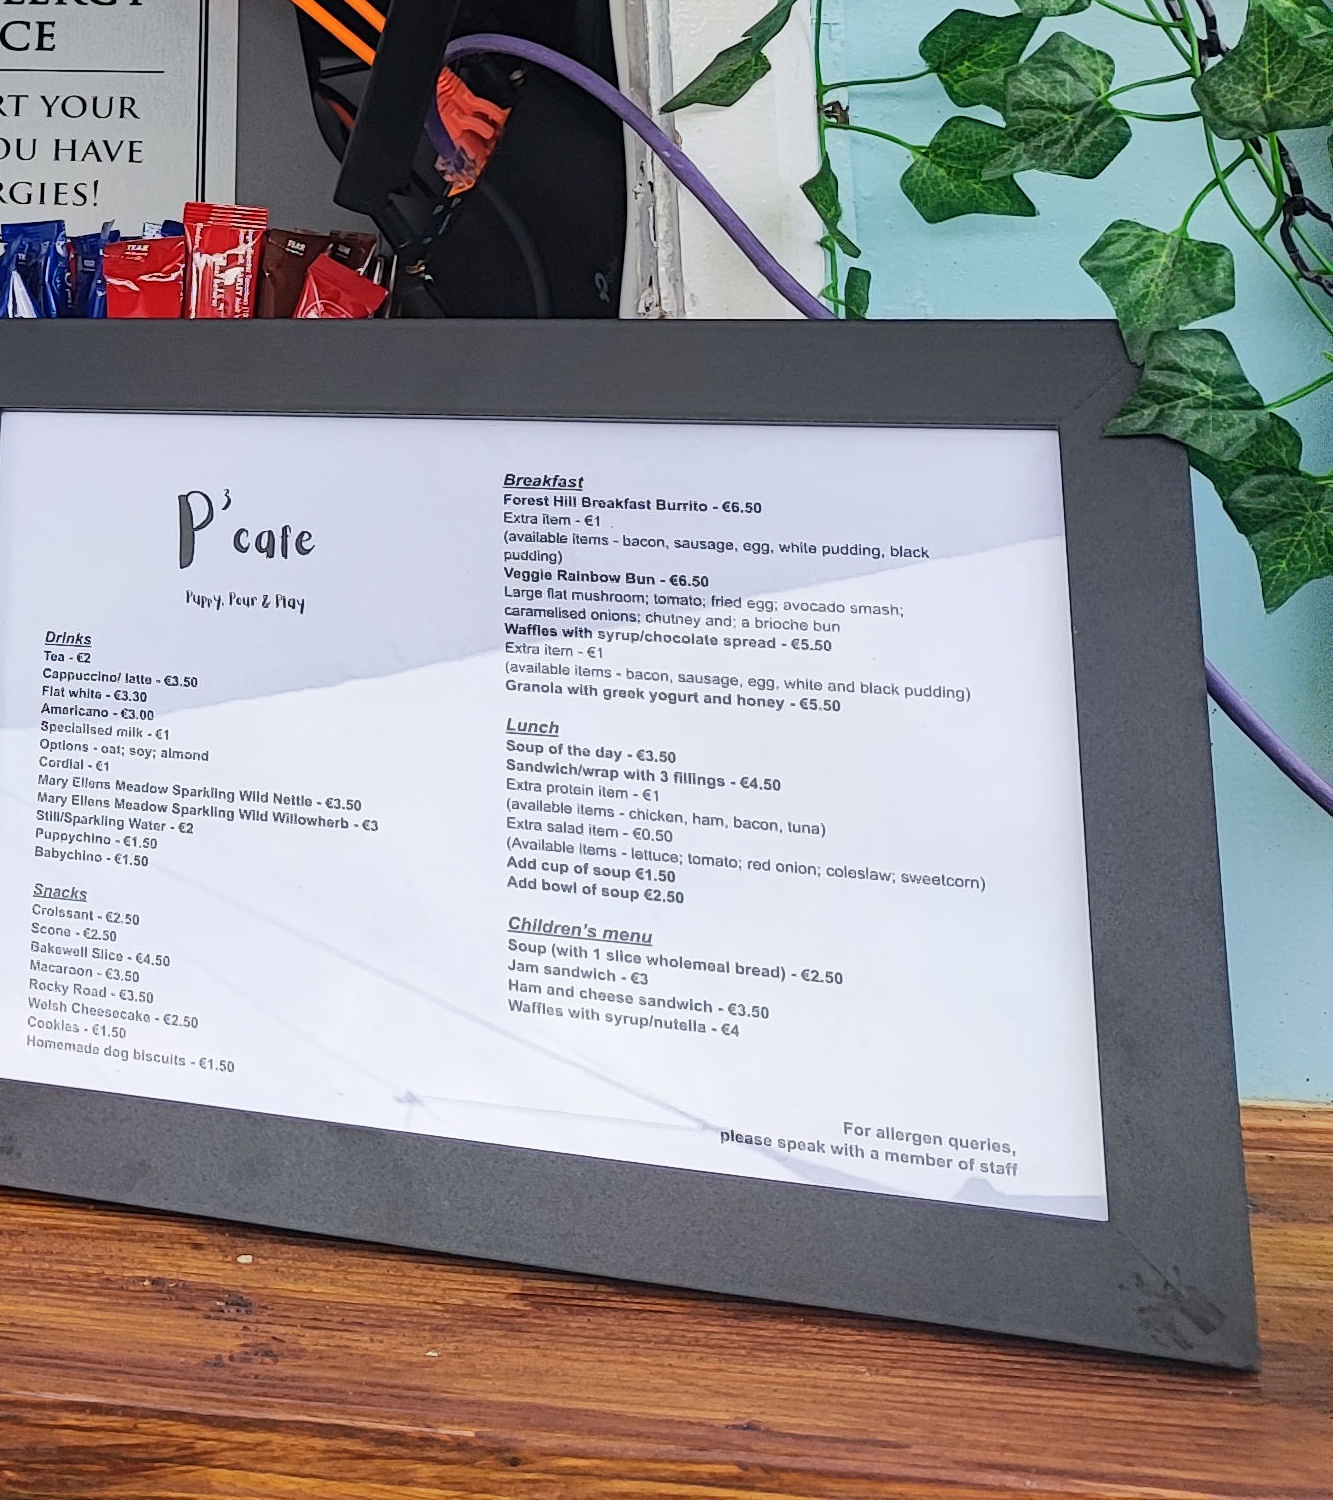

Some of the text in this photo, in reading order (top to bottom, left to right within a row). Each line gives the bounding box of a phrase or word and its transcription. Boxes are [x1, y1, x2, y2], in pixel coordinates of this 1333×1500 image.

[39, 95, 141, 120] YOUR
[52, 138, 144, 163] HAVE
[502, 473, 585, 489] Breakfast
[503, 493, 762, 514] Forest Hill Breakfast Burrito €6.50
[233, 524, 316, 560] cafe
[503, 566, 709, 588] Veggie Rainbow Bun €6.50
[228, 591, 258, 609] Pour
[261, 594, 271, 609] &
[275, 593, 305, 615] Play
[44, 630, 92, 646] Drinks
[43, 650, 91, 664] Tea €2
[41, 685, 65, 698] Flat
[113, 689, 148, 703] €3.30
[505, 679, 841, 712] Granola with greek yogurt and honey €5.50
[40, 702, 155, 721] Americano €3.00
[504, 717, 560, 736] Lunch
[506, 739, 677, 764] Soup of the day €3.50
[38, 755, 109, 772] Cordial €1
[37, 774, 362, 812] Mary Ellens Meadow Sparkling Wild Nettle €3.50
[35, 827, 158, 850] Puppychino €1.50
[34, 845, 149, 867] Babychino €1.50
[32, 882, 88, 901] Snacks
[506, 875, 685, 904] Add bowl of soup €2.50
[32, 903, 140, 926] Croissant €2.50
[602, 929, 653, 945] menu
[30, 940, 171, 967] Bakewell Slice €4.50
[29, 959, 140, 983] Macaroon €3.50
[508, 978, 770, 1020] Ham and cheese sandwich €3.50
[507, 998, 740, 1037] Waffles with syrup/nutella €4
[26, 1034, 235, 1073] Homemade dog biscuits €1.50
